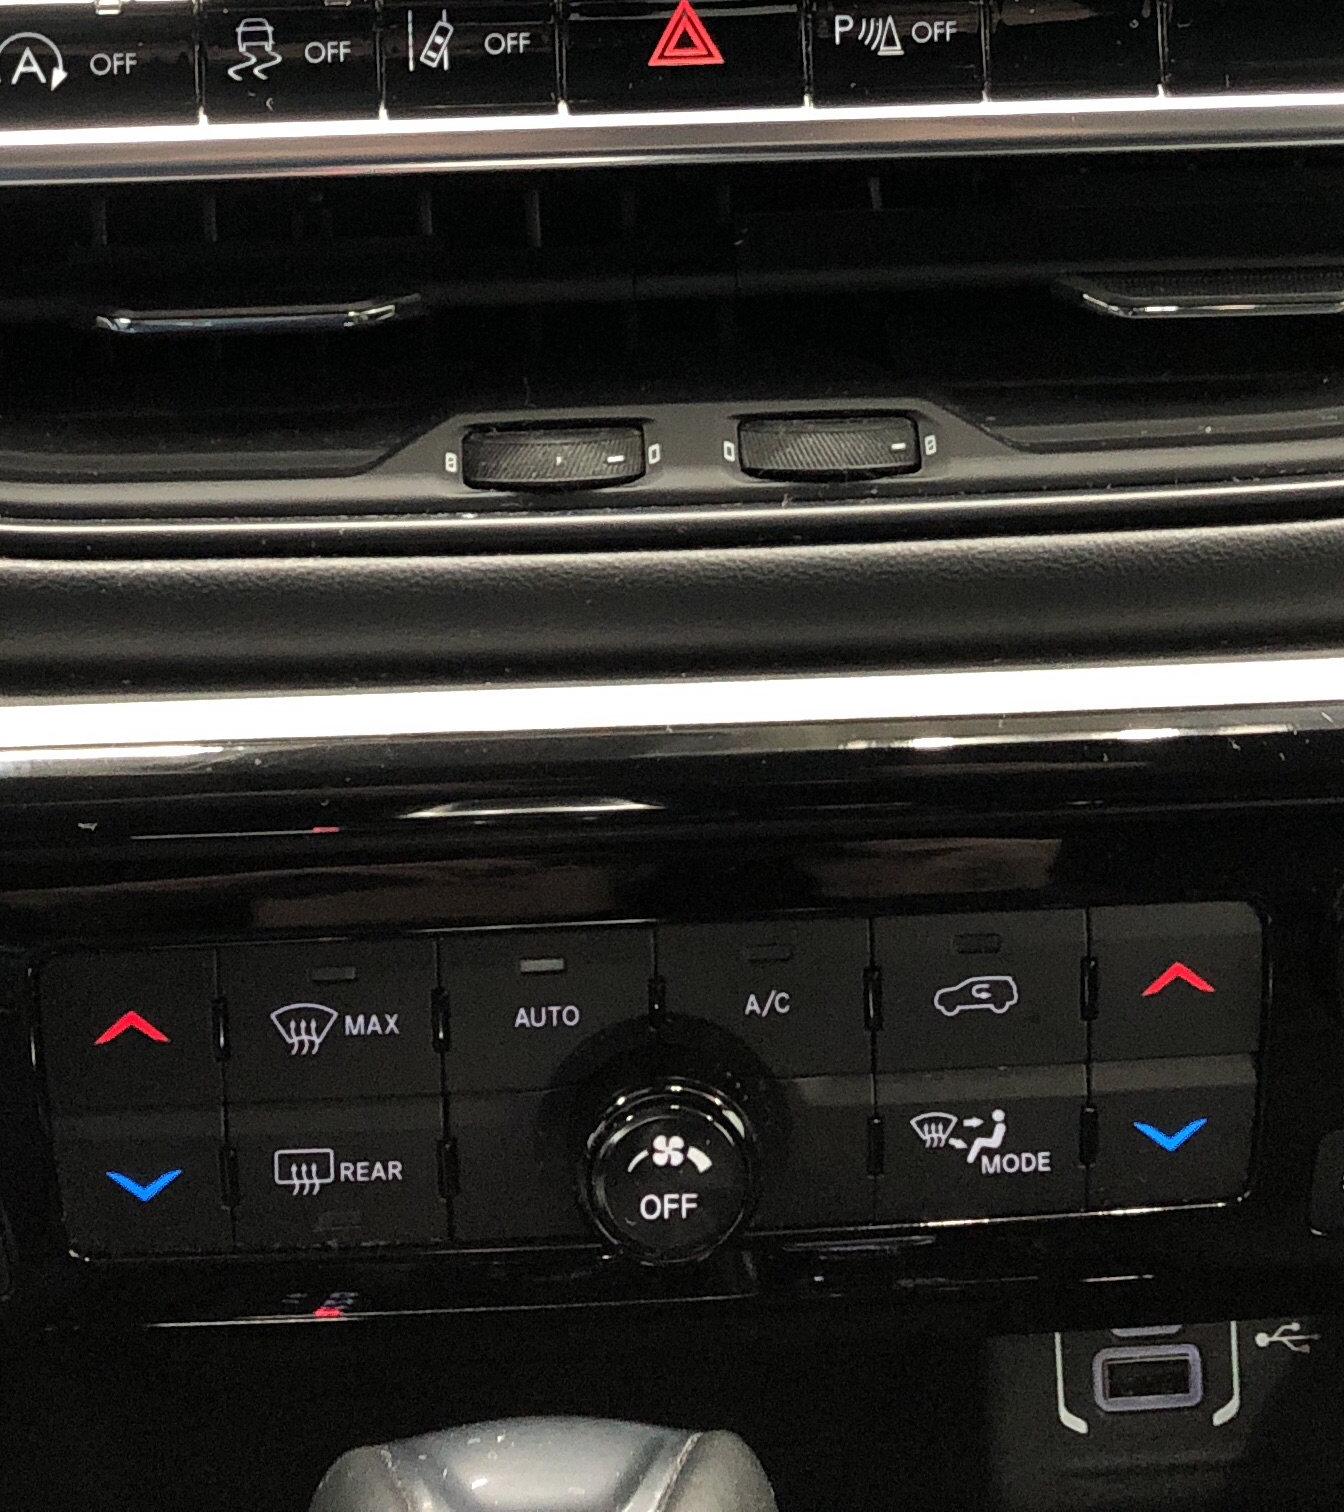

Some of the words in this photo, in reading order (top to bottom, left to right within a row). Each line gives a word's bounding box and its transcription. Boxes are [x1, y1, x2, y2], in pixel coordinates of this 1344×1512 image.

[484, 31, 532, 56] OFF
[911, 19, 958, 44] OFF
[89, 52, 138, 76] OFF
[304, 40, 353, 65] OFF
[744, 990, 791, 1017] A/C
[343, 1013, 400, 1037] MAX
[513, 1004, 580, 1029] AUTO
[339, 1159, 404, 1183] REAR
[980, 1150, 1052, 1175] MODE
[640, 1193, 698, 1221] OFF
